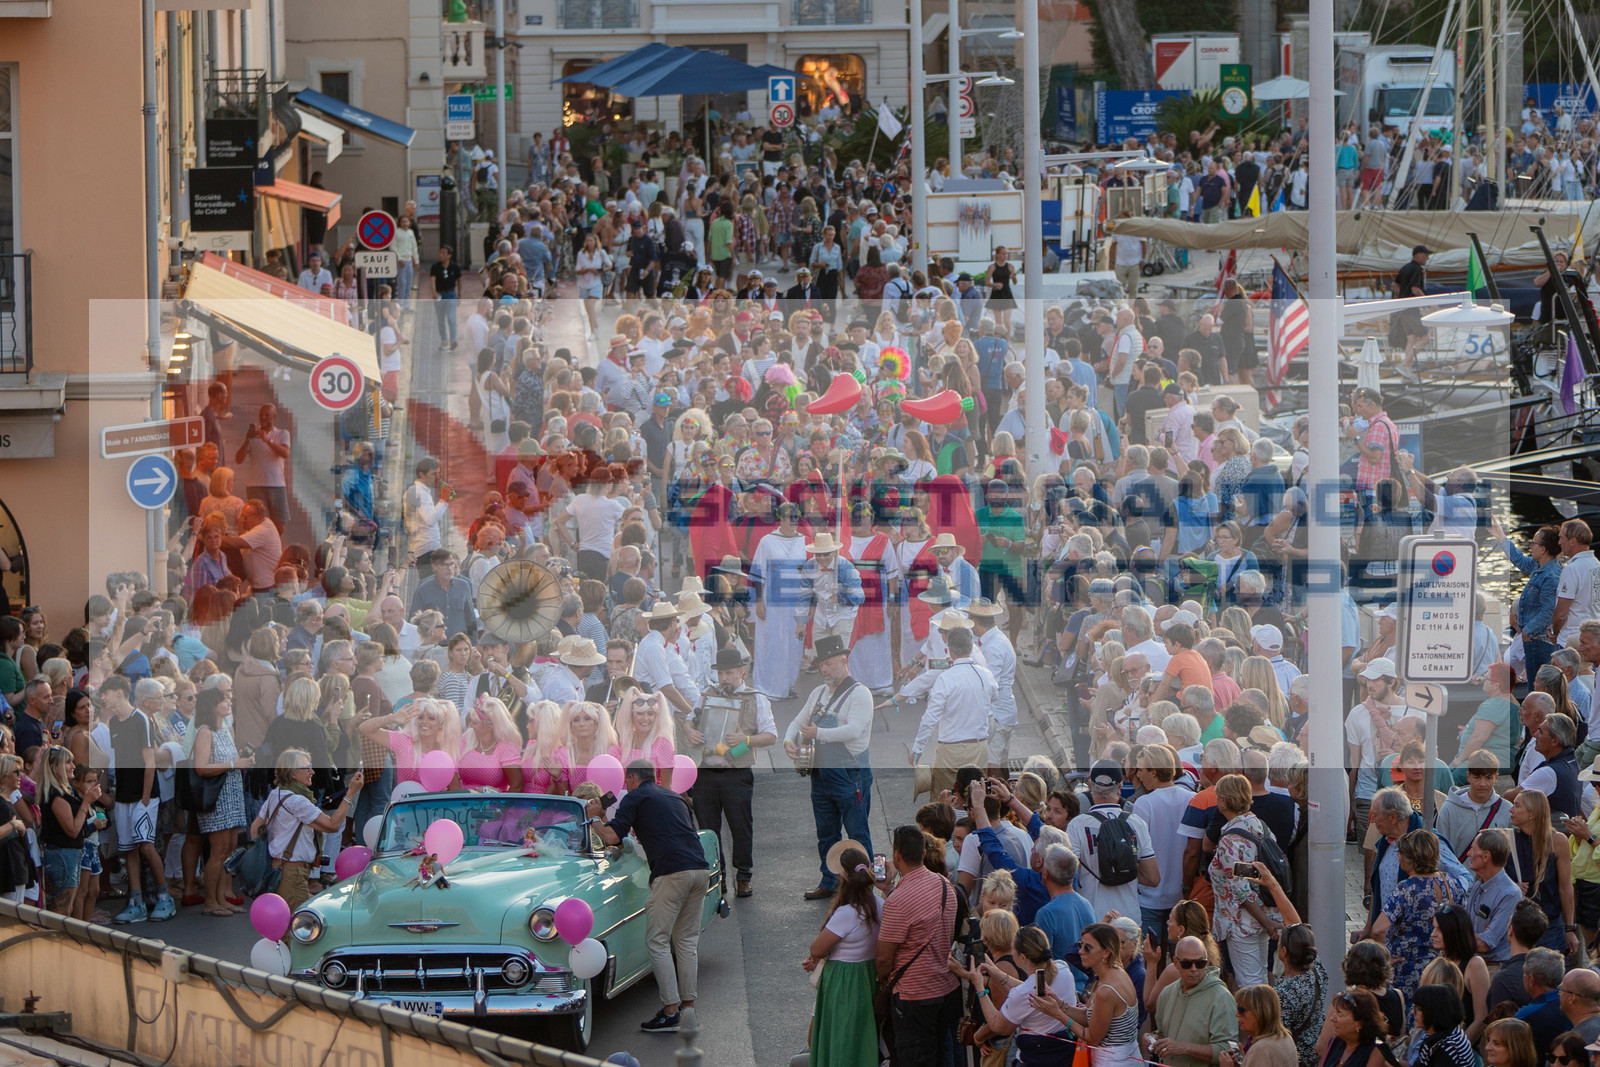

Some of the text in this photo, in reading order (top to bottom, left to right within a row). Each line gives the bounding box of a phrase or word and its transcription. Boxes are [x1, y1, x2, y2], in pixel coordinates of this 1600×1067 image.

[449, 103, 472, 112] TAXIS
[776, 110, 790, 120] 30
[1098, 91, 1106, 144] EXPOSITION
[363, 255, 389, 263] SAUF
[366, 266, 390, 275] AXIS
[321, 371, 353, 394] 30
[123, 437, 129, 445] de
[130, 432, 170, 443] l'ANNONCIADE
[1414, 581, 1470, 589] SAUF LIVRAISONS
[1432, 612, 1460, 620] MOTOS
[1415, 623, 1426, 631] DE
[1429, 623, 1443, 631] 11H
[1411, 652, 1465, 660] STATIONNEMENT
[1422, 663, 1454, 672] GÊNANT
